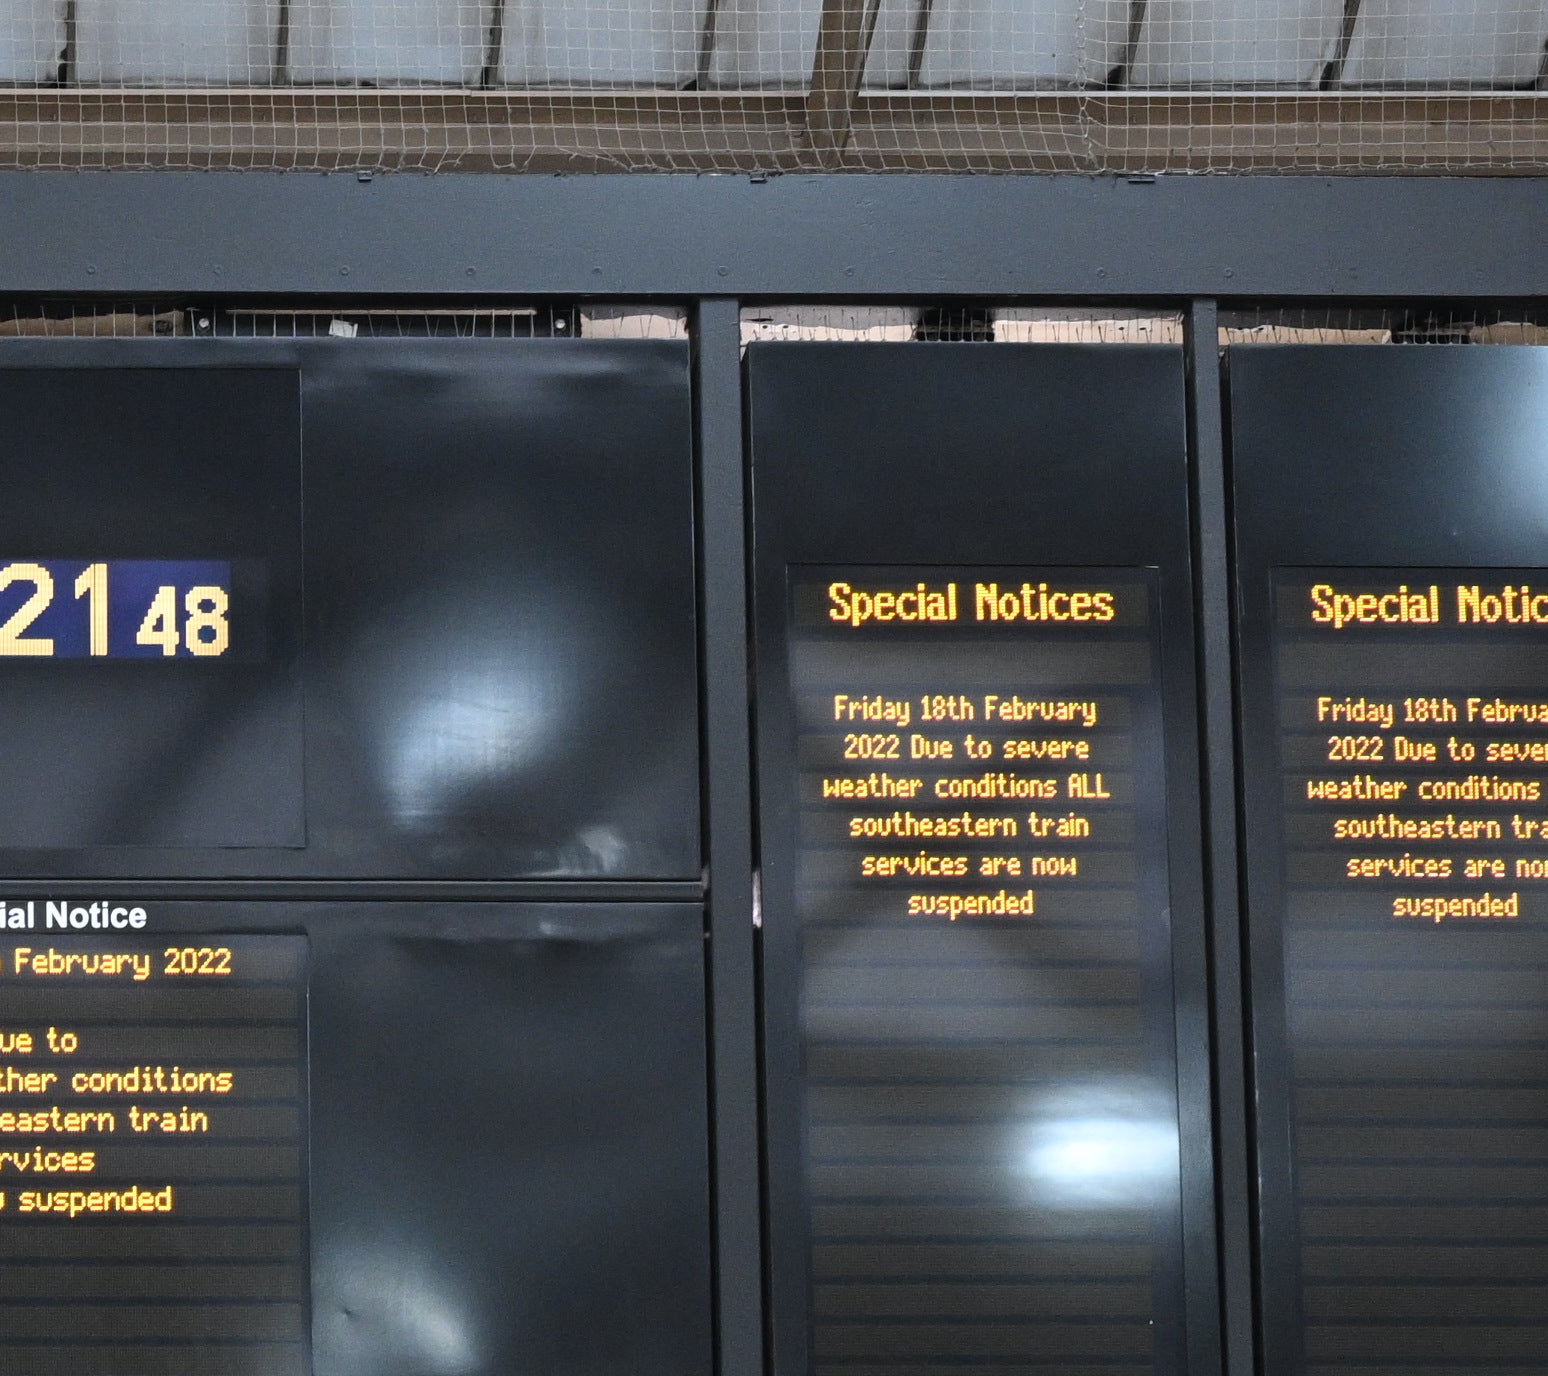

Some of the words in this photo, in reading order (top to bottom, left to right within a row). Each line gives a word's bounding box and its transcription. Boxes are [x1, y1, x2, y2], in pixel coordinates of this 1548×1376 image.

[134, 585, 231, 657] 48
[828, 582, 959, 627] Special
[974, 582, 1115, 622] Notices
[1310, 584, 1440, 629] Special
[45, 900, 147, 929] Notice
[14, 947, 151, 981] February
[164, 947, 232, 975] 2022
[46, 1026, 78, 1054] to
[71, 1066, 233, 1094] conditions
[128, 1105, 209, 1133] train
[18, 1185, 174, 1218] suspended
